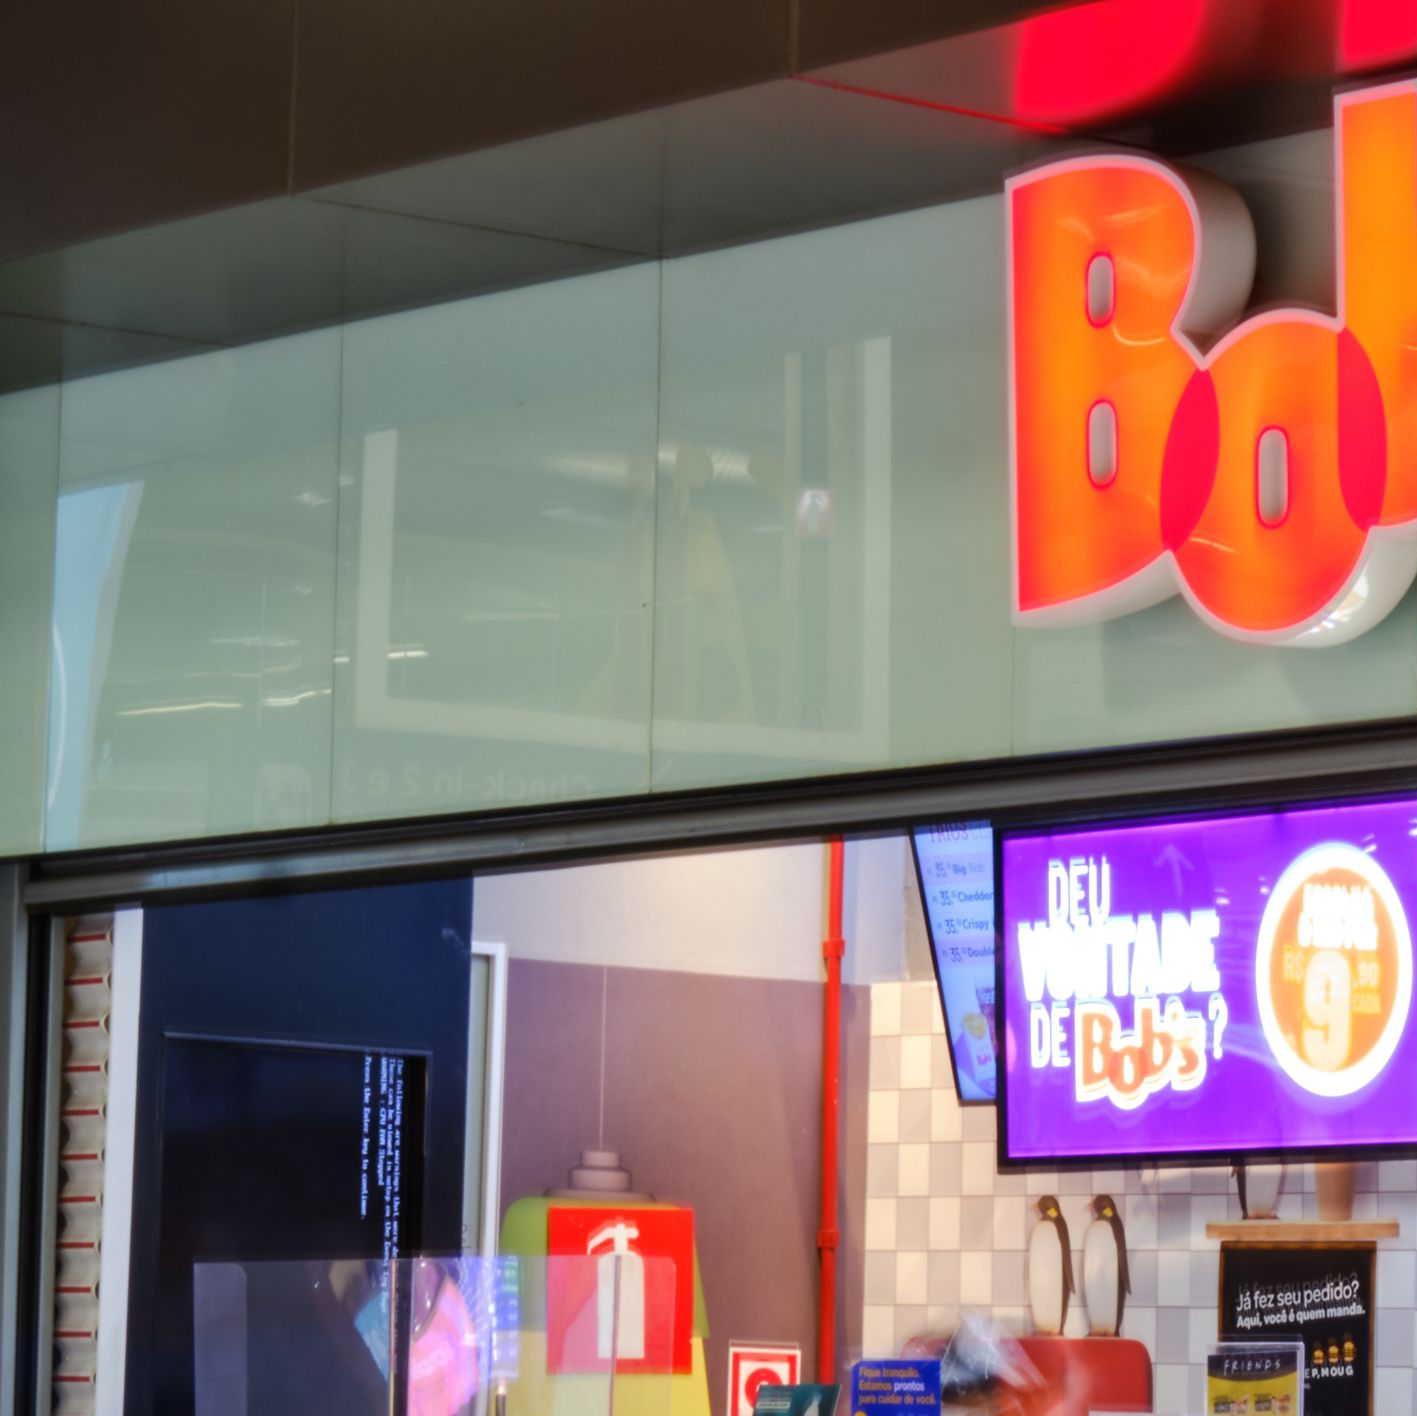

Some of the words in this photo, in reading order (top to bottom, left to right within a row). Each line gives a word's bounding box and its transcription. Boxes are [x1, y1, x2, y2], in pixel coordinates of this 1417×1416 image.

[1048, 856, 1111, 924] DEU
[1031, 1001, 1071, 1068] DE
[1236, 1292, 1251, 1311] Já
[1253, 1290, 1275, 1309] fez
[1277, 1290, 1301, 1307] seu
[1303, 1280, 1360, 1308] pedido?
[1236, 1313, 1262, 1329] Aqui,
[1264, 1309, 1287, 1325] você
[1288, 1308, 1296, 1322] é
[1296, 1309, 1326, 1324] quem
[1326, 1302, 1366, 1318] manda.
[1223, 1359, 1281, 1377] FRIENDS
